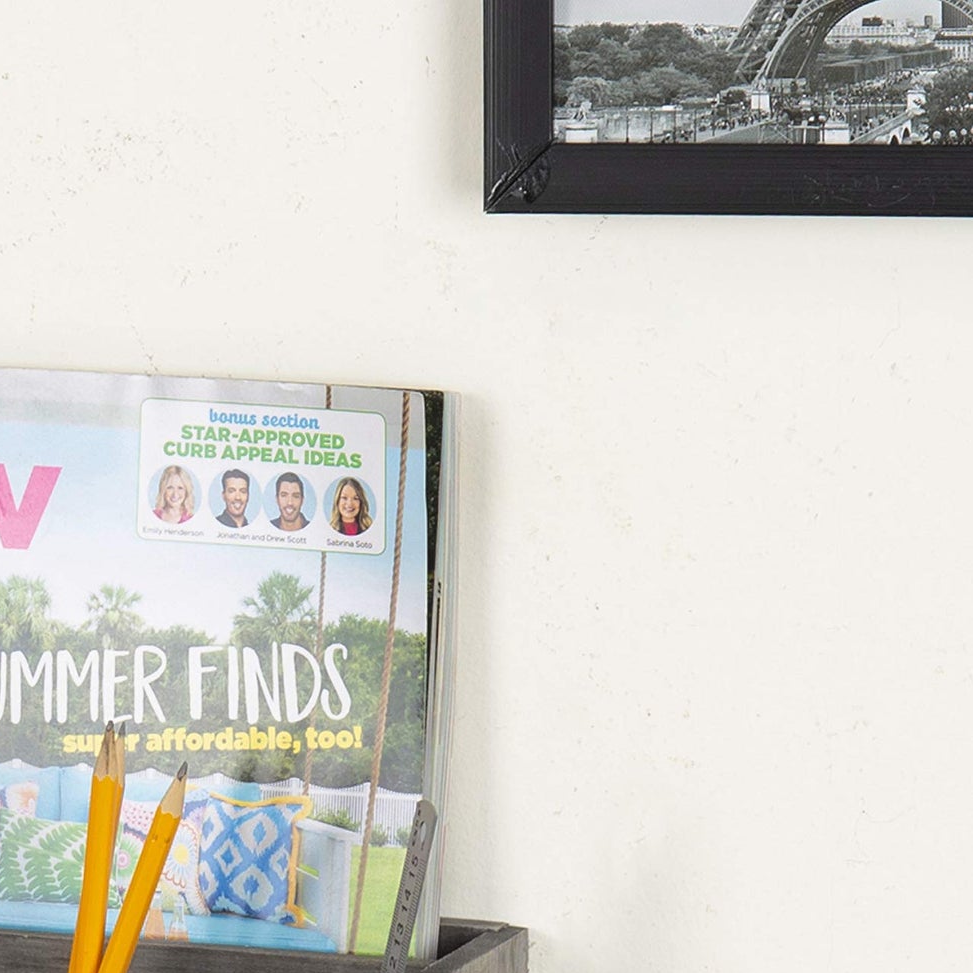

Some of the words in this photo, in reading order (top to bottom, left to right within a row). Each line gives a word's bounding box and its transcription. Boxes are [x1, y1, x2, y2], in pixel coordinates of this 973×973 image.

[209, 408, 257, 426] bonus
[261, 413, 320, 430] section
[181, 425, 345, 450] STAR-APPROVED
[163, 441, 217, 459] CURB
[221, 444, 299, 465] APPEAL
[304, 450, 363, 469] IDEAS
[164, 527, 205, 537] Henderson
[216, 531, 250, 540] Jonathan
[251, 533, 266, 542] and
[267, 534, 286, 543] Drew
[287, 535, 307, 545] Scott
[327, 538, 355, 548] Sabrina
[355, 540, 373, 549] Soto
[188, 642, 353, 724] FINDS
[63, 733, 140, 757] sur
[146, 726, 301, 754] affordable,
[305, 726, 363, 749] too!
